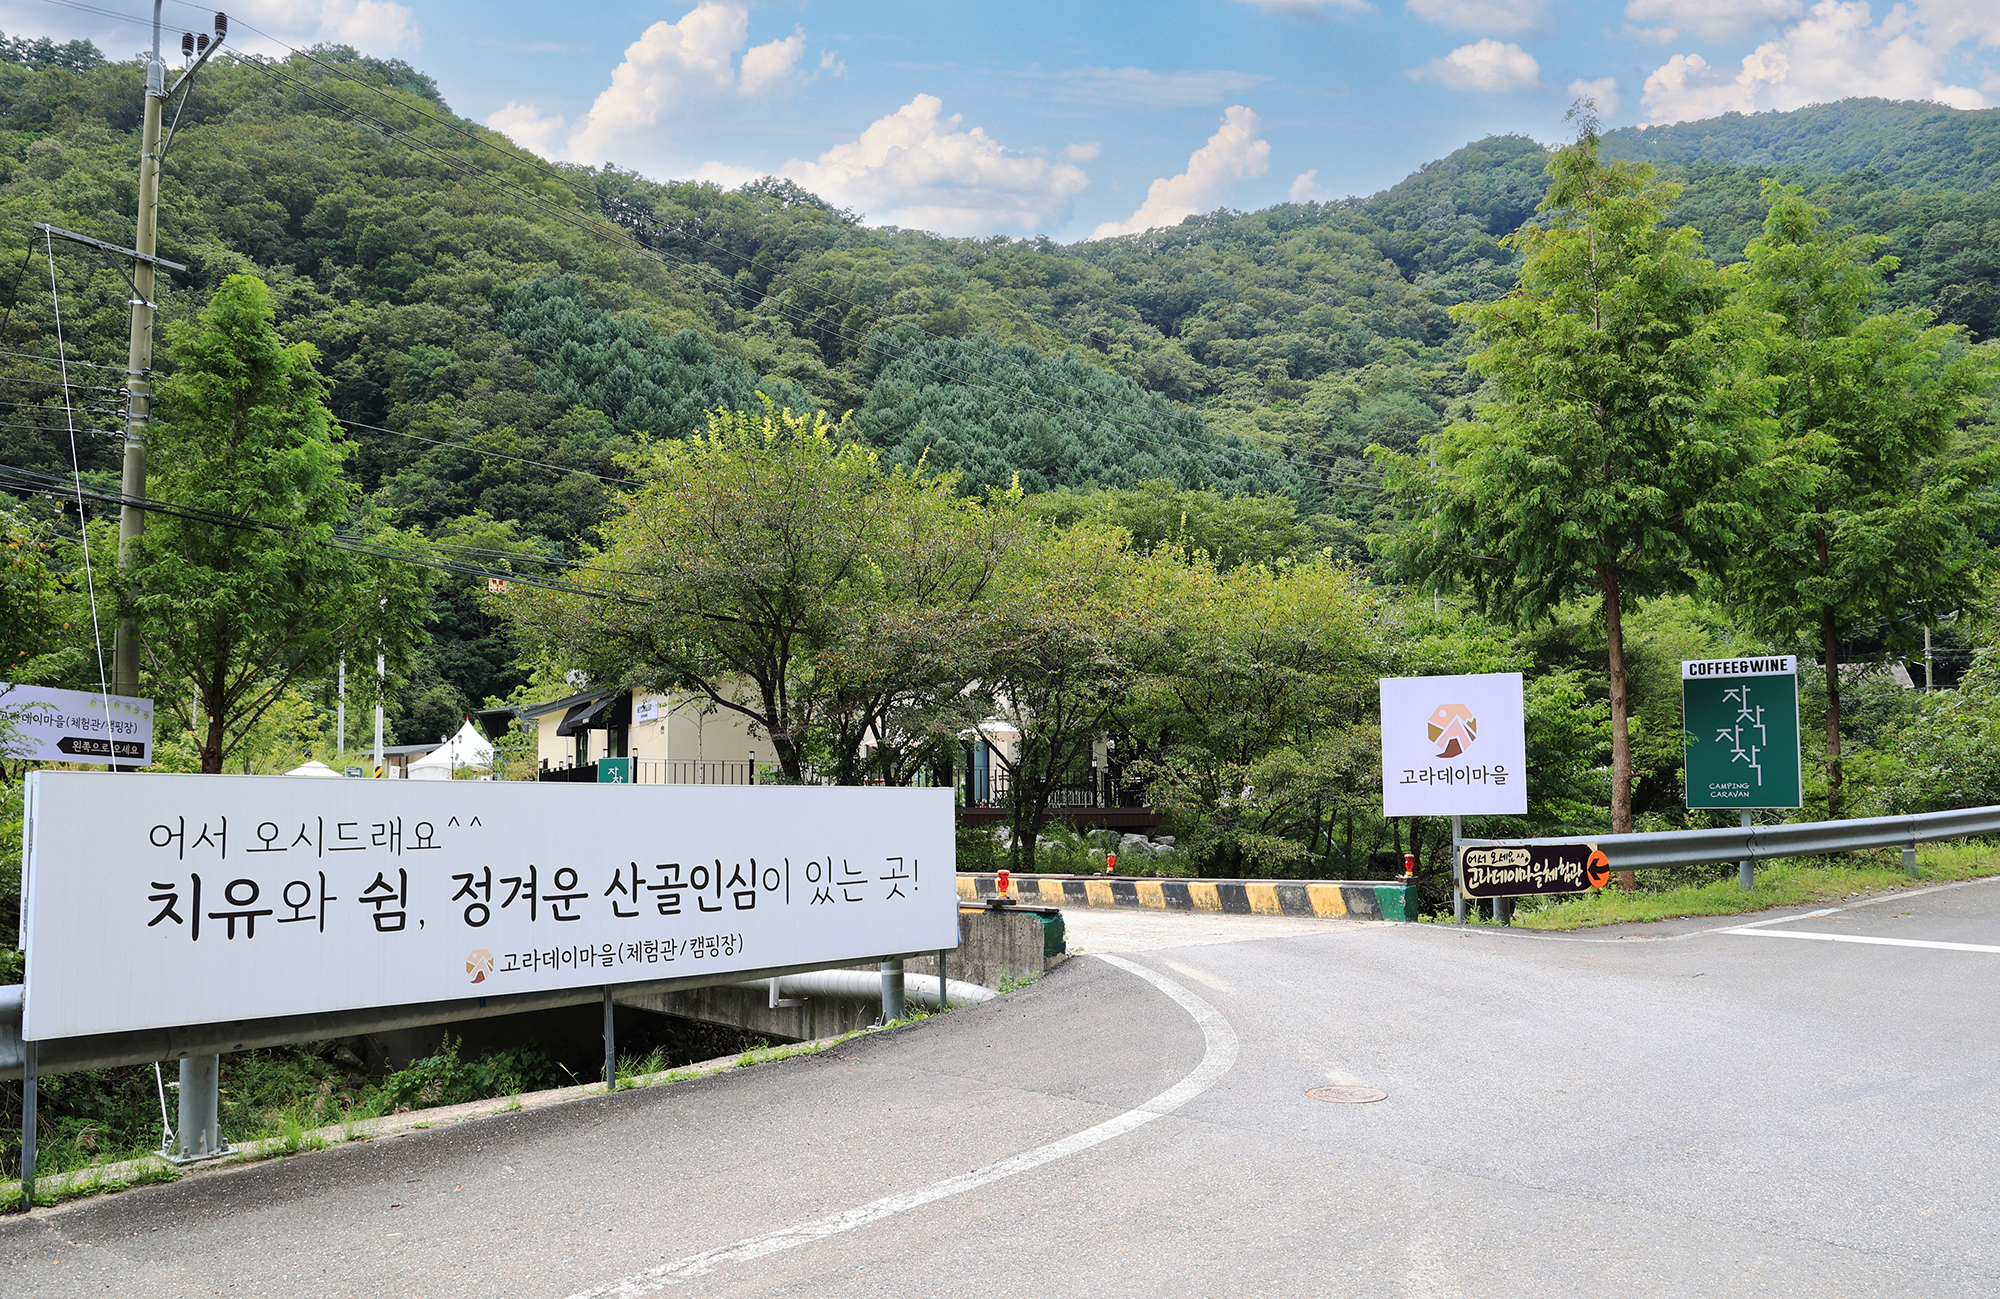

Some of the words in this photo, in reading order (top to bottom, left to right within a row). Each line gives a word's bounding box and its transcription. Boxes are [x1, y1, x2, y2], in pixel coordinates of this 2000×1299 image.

[1689, 659, 1788, 676] COFFEE&WINE
[72, 740, 110, 753] 왼쪽으로
[114, 744, 139, 755] 오세요
[1399, 764, 1509, 786] 고라데이마을
[1710, 790, 1750, 798] CARAVAN
[149, 815, 227, 860] 어서
[147, 871, 338, 941] 치유와
[358, 867, 425, 932] 쉼,
[451, 864, 589, 928] 정겨운
[603, 857, 791, 918] 산골인심이
[805, 855, 869, 905] 있는
[879, 856, 918, 901] 곳!
[499, 932, 743, 973] 고라데이마을(체험관/캠핑장)
